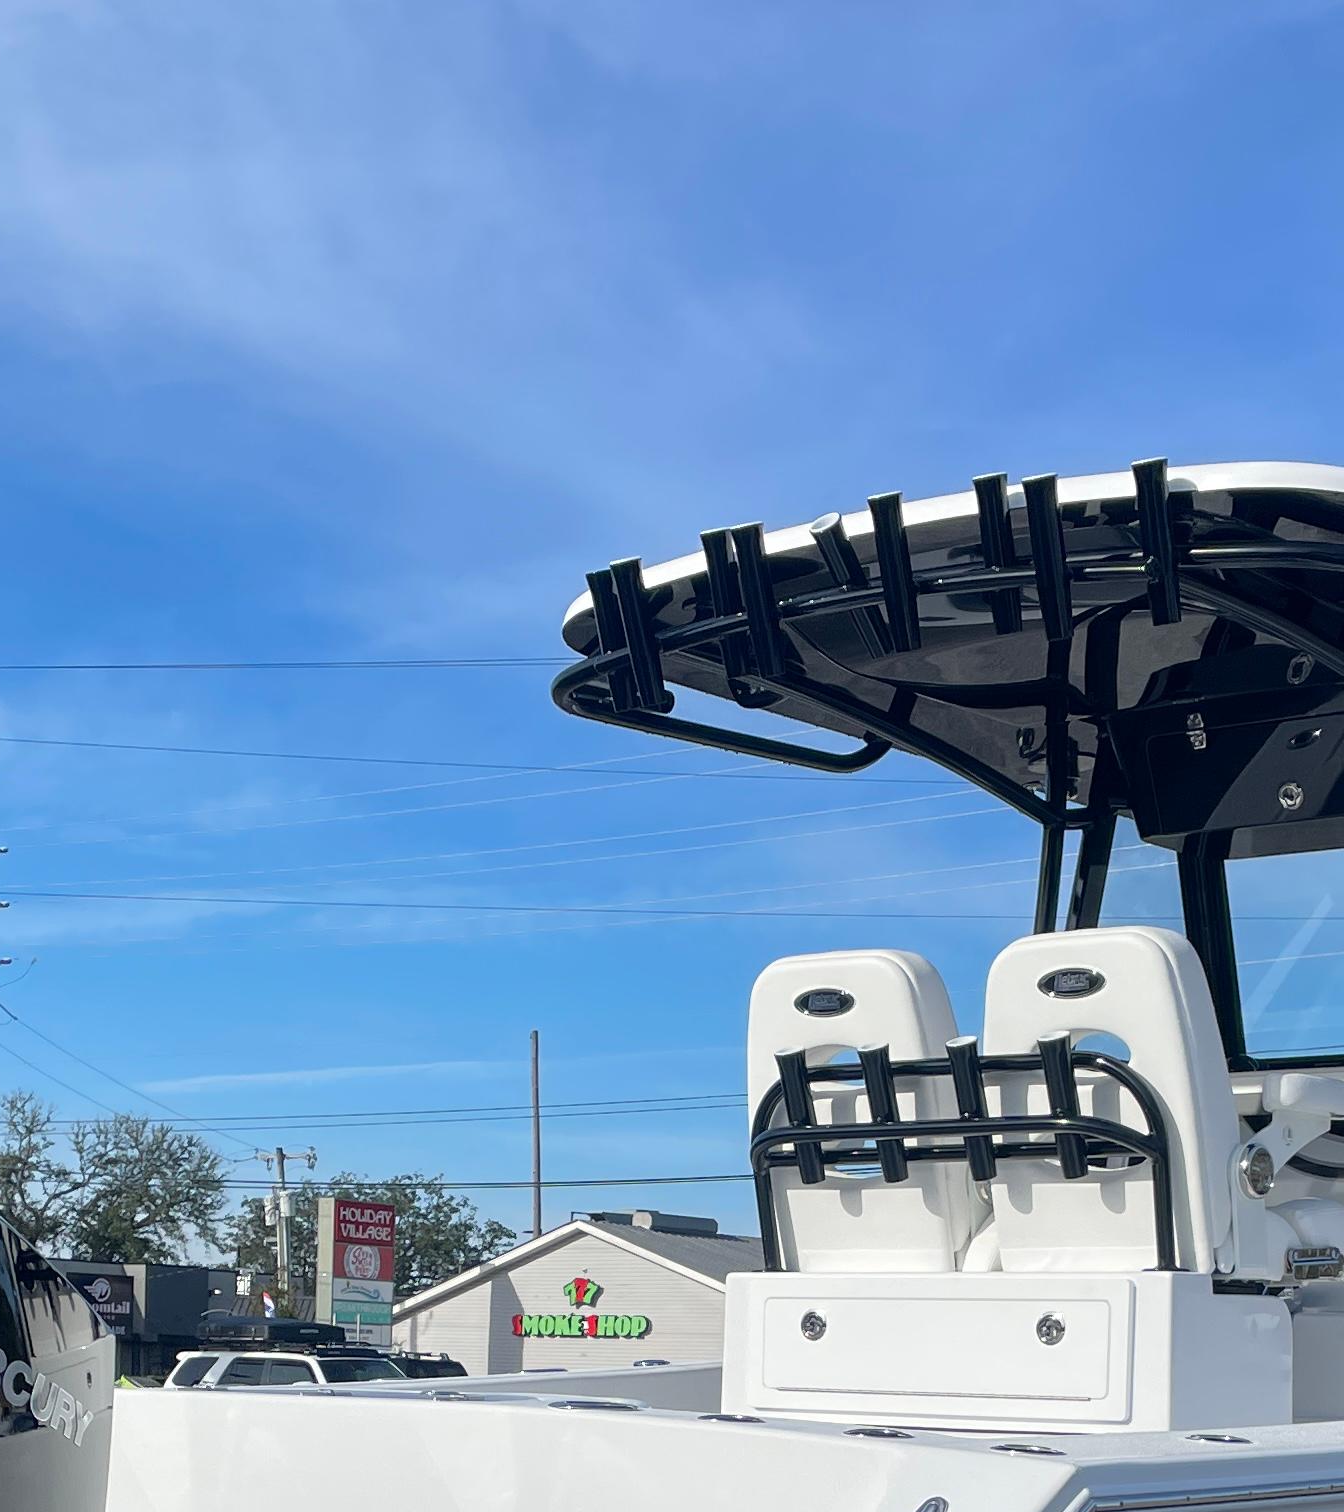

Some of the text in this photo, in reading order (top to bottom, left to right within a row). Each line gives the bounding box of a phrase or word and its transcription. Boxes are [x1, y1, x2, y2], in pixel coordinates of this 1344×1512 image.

[339, 1206, 392, 1224] HOLIDAY
[340, 1223, 391, 1241] VILLAGE
[563, 1277, 600, 1306] 777
[512, 1314, 648, 1337] SMOKE SHOP
